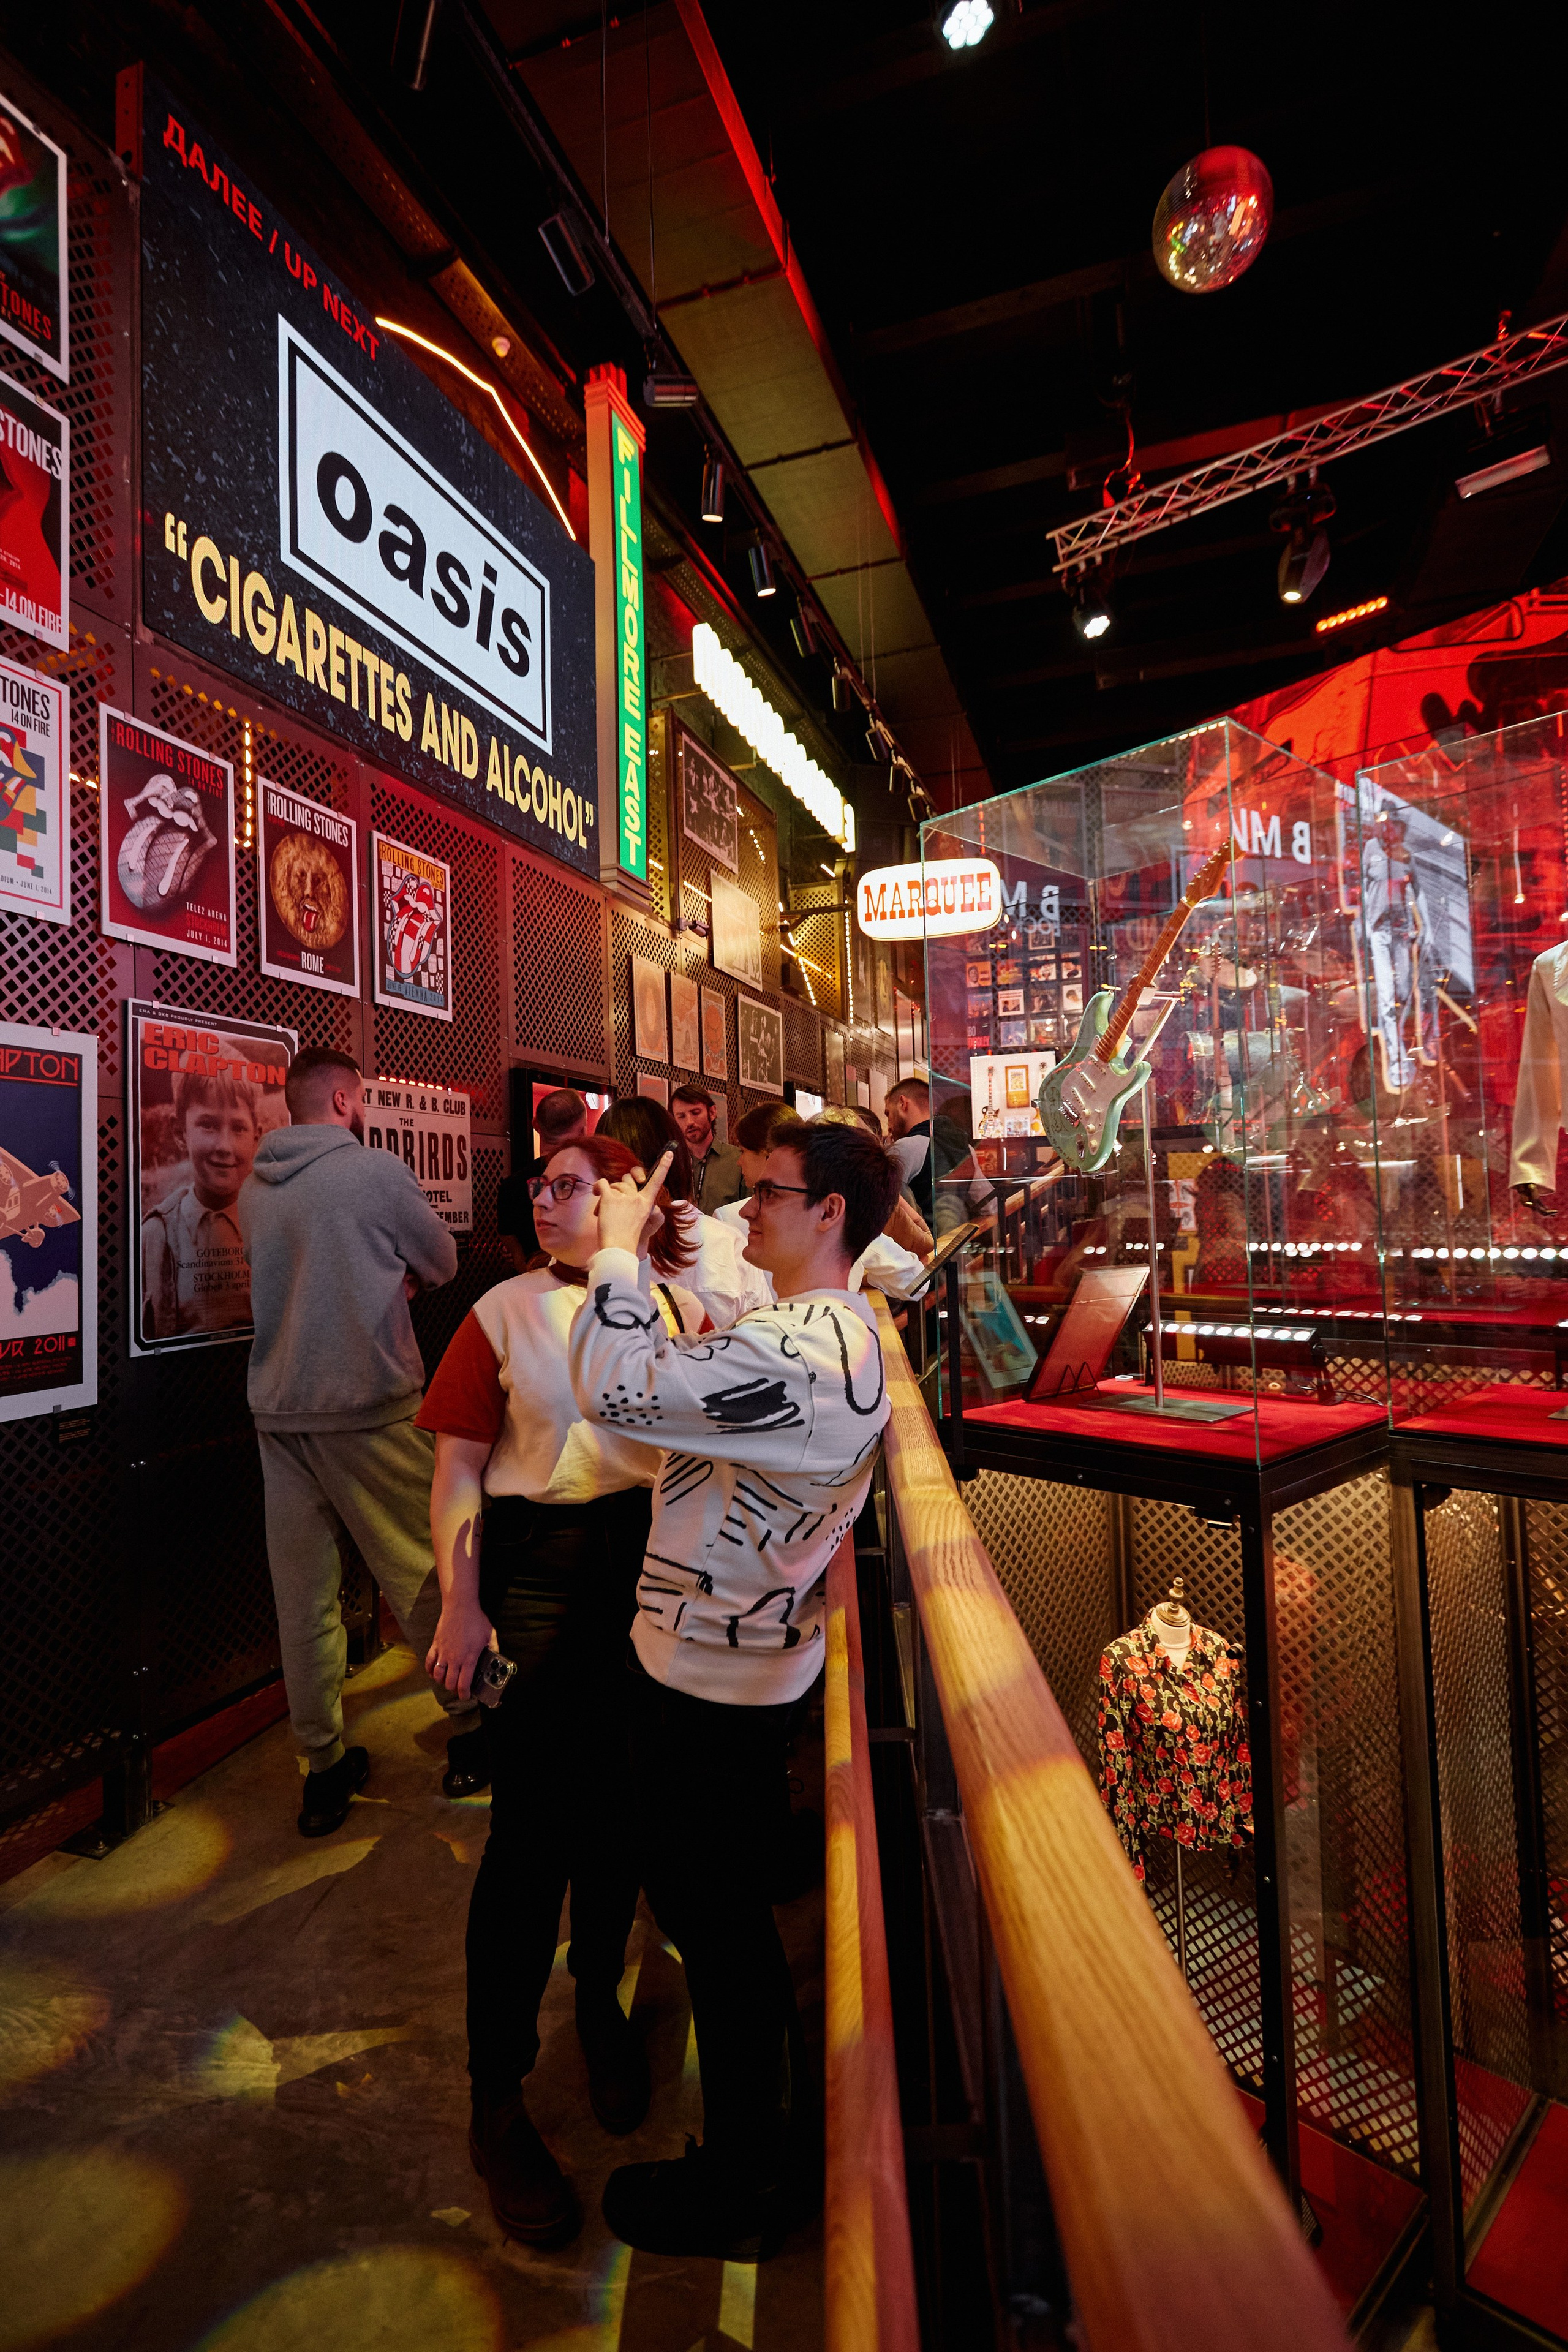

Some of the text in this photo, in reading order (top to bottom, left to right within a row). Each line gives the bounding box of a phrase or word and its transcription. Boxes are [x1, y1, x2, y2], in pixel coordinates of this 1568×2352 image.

[163, 113, 263, 242] ДАЛЕЕ
[284, 240, 317, 291] UP
[323, 282, 380, 361] NEXT
[316, 451, 532, 677] oasis
[19, 595, 36, 623] ON
[618, 426, 641, 867] FILLMORE EAST
[12, 709, 50, 737] 14 ON FIRE
[421, 692, 478, 780] AND
[116, 722, 173, 768] ROLLING
[177, 750, 224, 790] STONES
[270, 791, 312, 832] ROLLING
[314, 812, 349, 848] STONES
[382, 844, 415, 873] ROLLING
[417, 859, 444, 885] STONES
[20, 880, 33, 890] JUNE
[41, 886, 52, 894] 2014
[864, 872, 991, 922] MARQUEE
[186, 902, 227, 922] TELE2 ARENA
[186, 929, 202, 941] JULY
[213, 936, 227, 948] 2014
[301, 951, 325, 974] ROME
[404, 983, 428, 1003] VIENNA
[430, 993, 444, 1005] 2014
[144, 1022, 219, 1055] ERIC
[144, 1047, 286, 1086] CLAPTON
[362, 1088, 466, 1115] T NEW R. & B. CLUB
[399, 1118, 414, 1127] THE
[423, 1190, 452, 1203] OTEL
[177, 1256, 233, 1269] Scandinavium
[193, 1270, 250, 1283] STOCKHOLM
[34, 1335, 65, 1355] 2011
